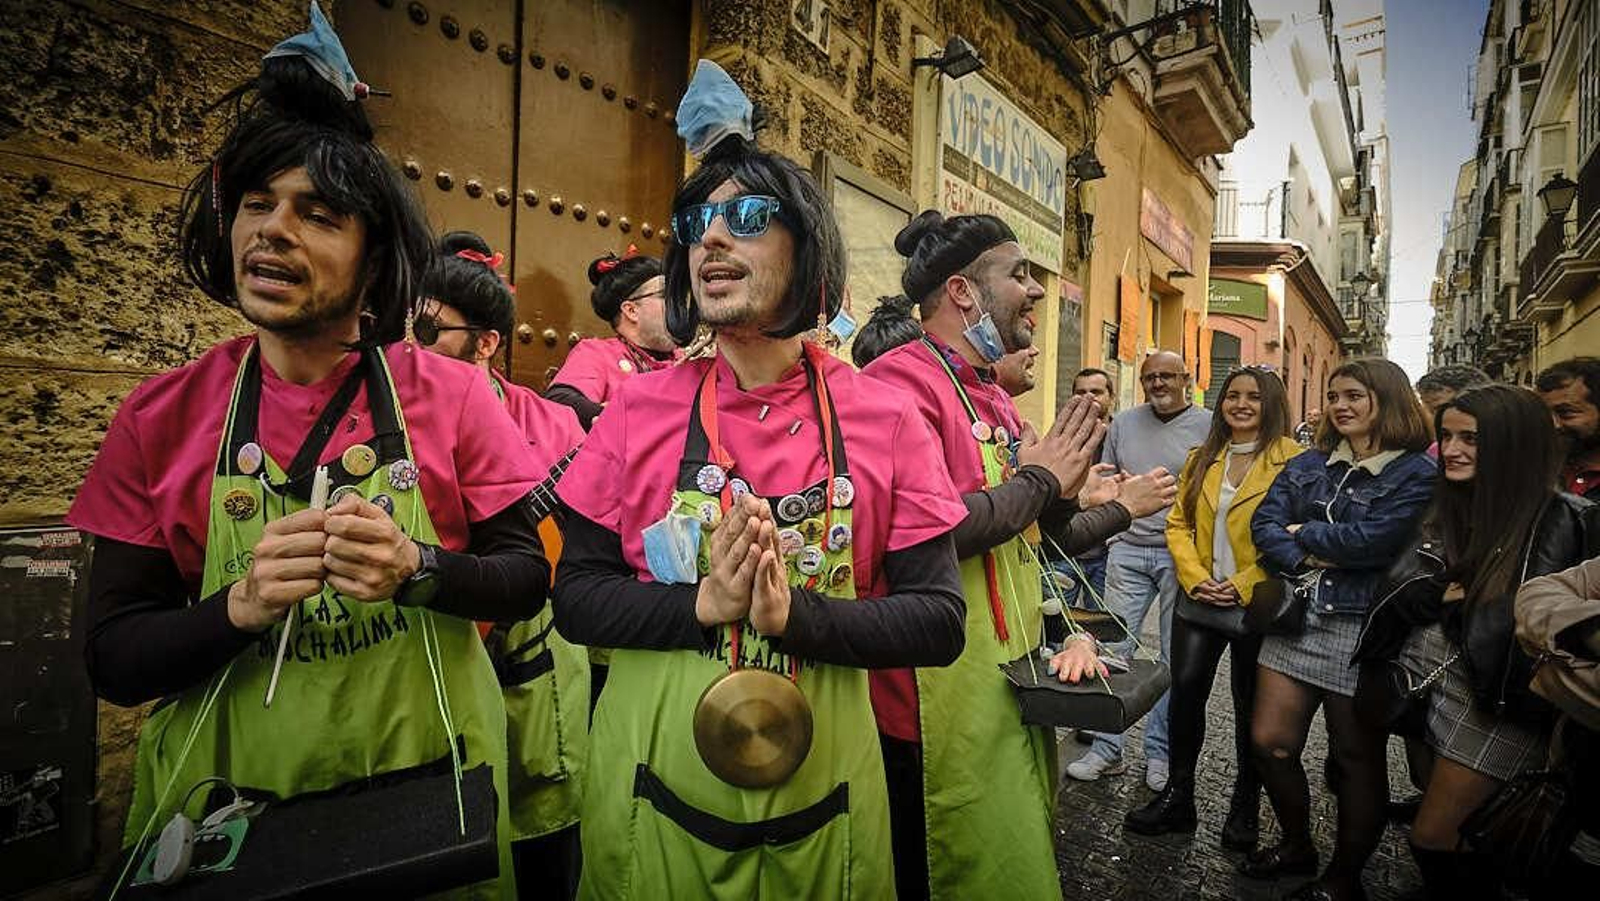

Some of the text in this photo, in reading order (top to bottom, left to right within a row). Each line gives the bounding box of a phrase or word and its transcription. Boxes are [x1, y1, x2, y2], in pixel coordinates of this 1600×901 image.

[947, 86, 1006, 177] VIDEO
[1010, 117, 1062, 214] SONIDO
[298, 592, 352, 629] LAS
